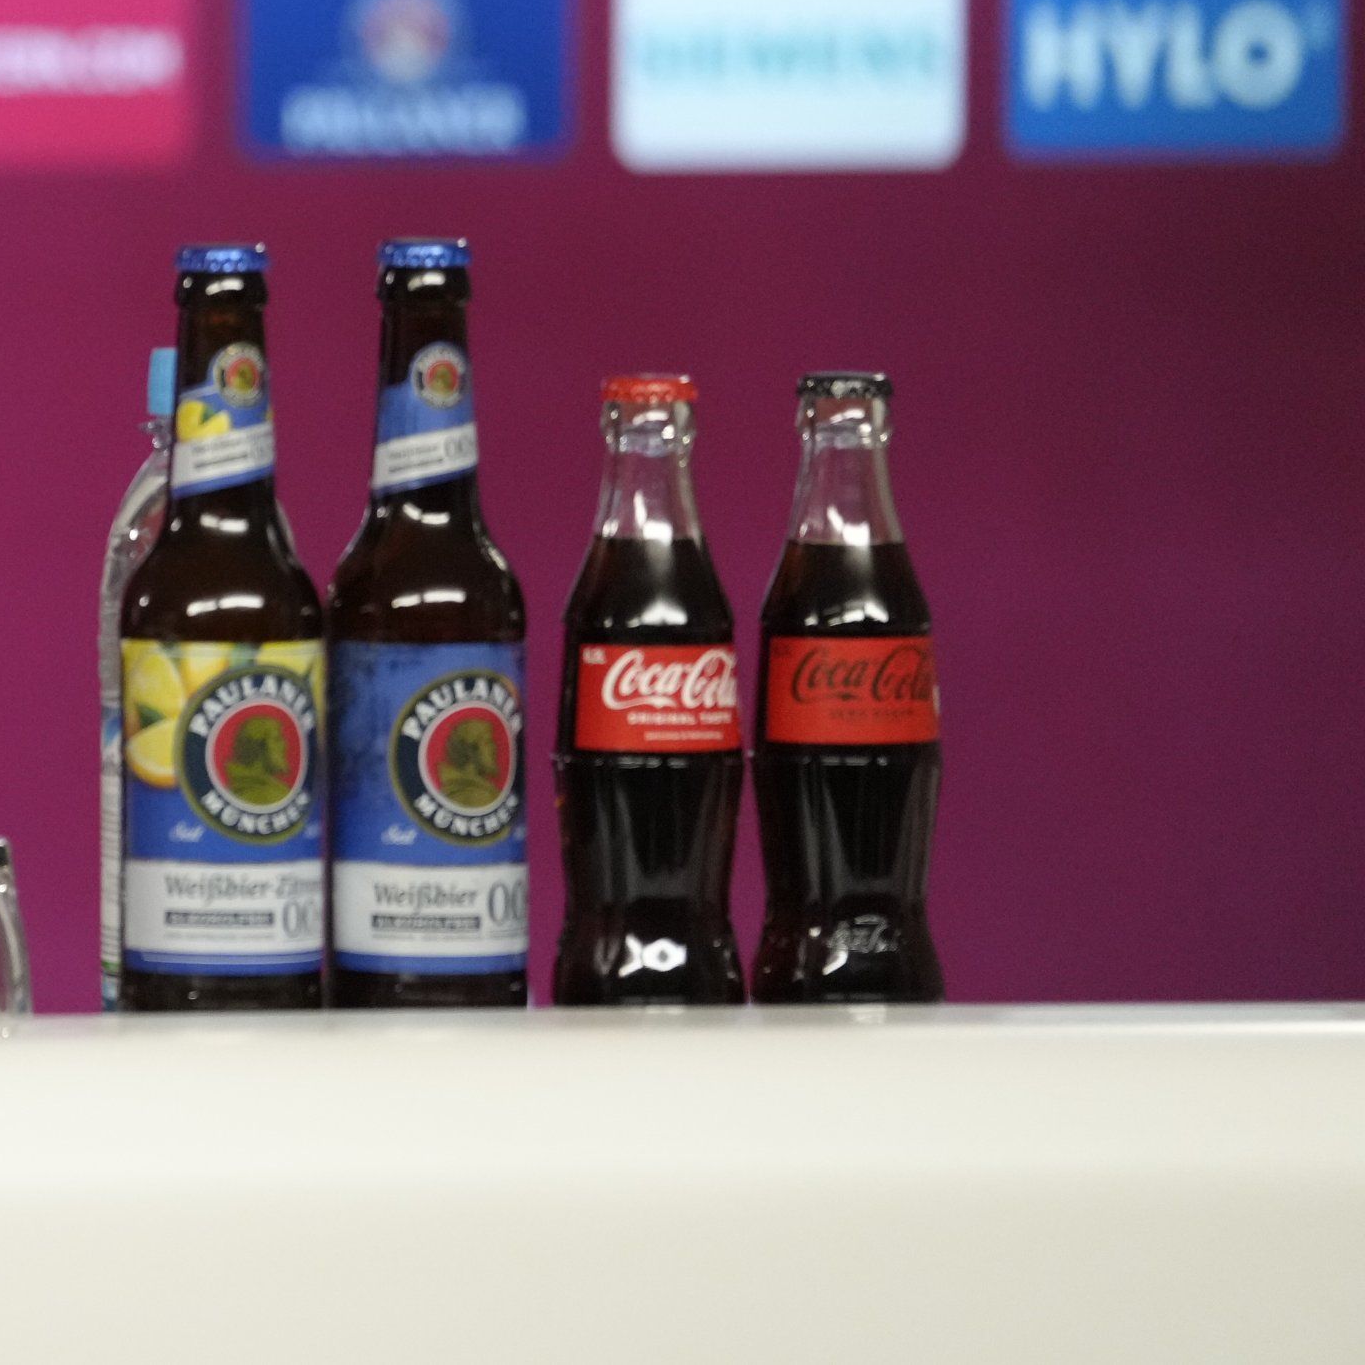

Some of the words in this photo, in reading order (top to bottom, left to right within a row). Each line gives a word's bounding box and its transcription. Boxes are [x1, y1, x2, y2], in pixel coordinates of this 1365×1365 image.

[1024, 0, 1303, 111] HYLO
[188, 674, 315, 737] PAULANER
[401, 677, 523, 741] PAULANER
[600, 648, 738, 711] Coca-Cola
